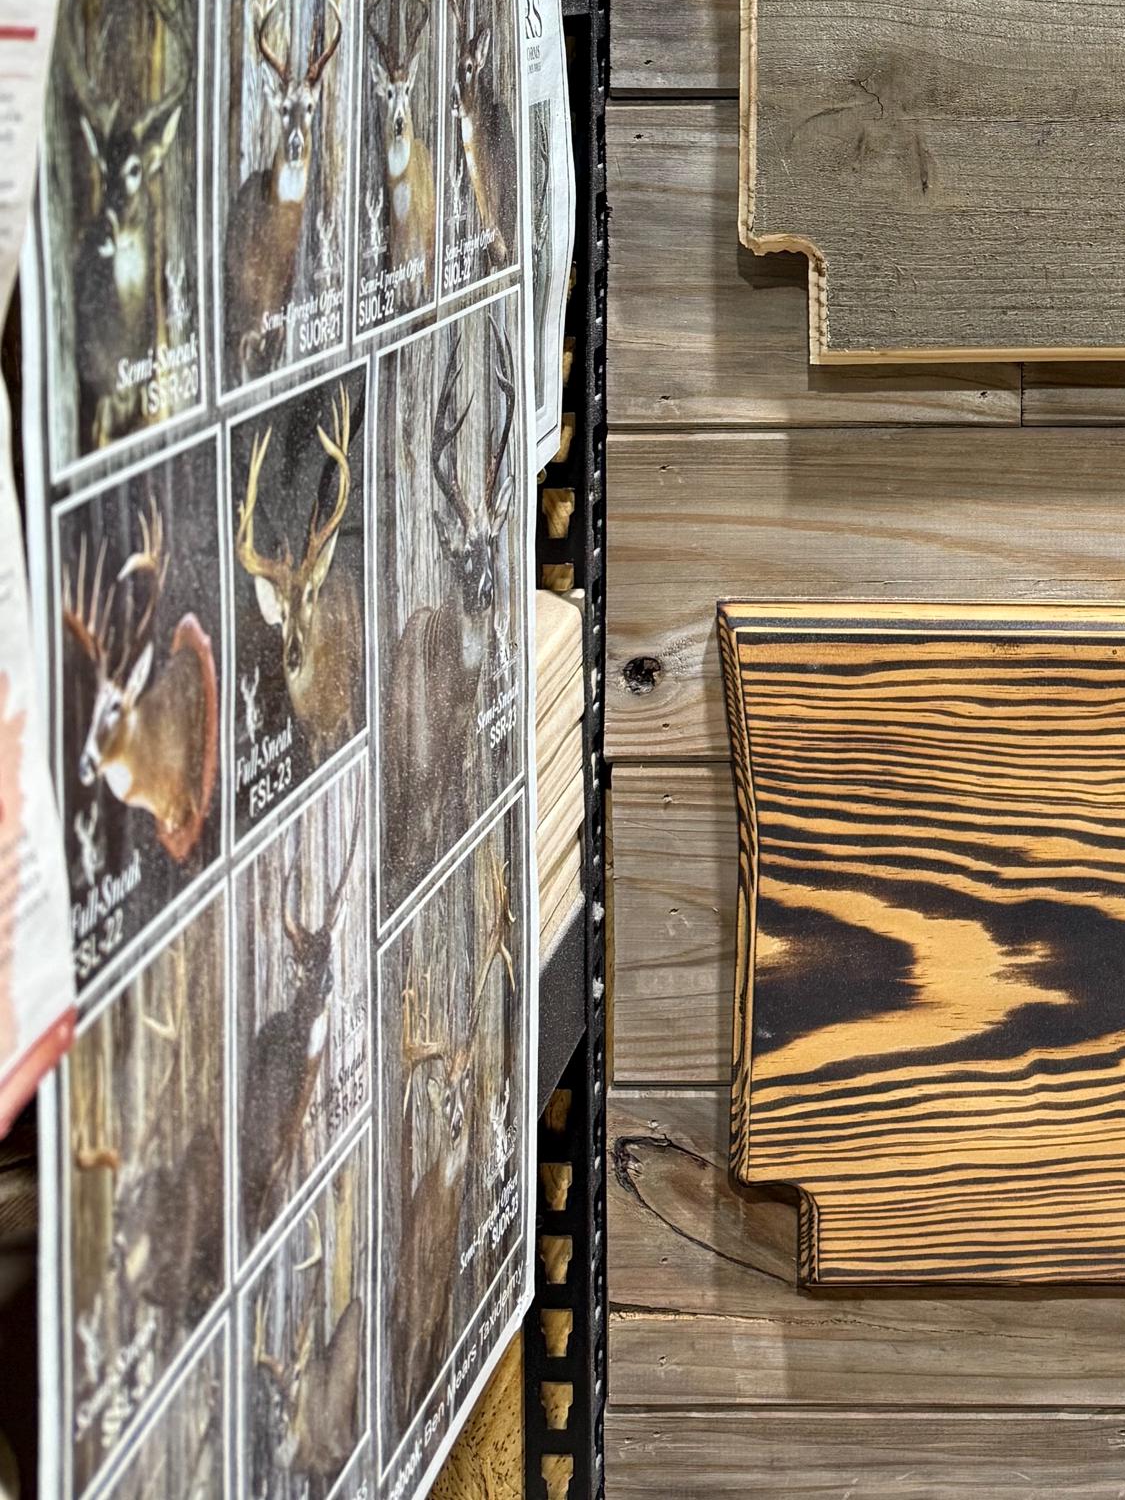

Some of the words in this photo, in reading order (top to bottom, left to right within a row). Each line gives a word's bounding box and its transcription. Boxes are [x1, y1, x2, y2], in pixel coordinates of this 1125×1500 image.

[359, 289, 394, 326] SUOL-22
[300, 311, 341, 352] SUOR-21
[490, 704, 517, 749] SSR-23
[250, 756, 292, 818] FSL-23
[424, 1403, 445, 1447] Ben
[447, 1343, 477, 1406] Mears
[478, 1260, 524, 1345] Taxidermy
